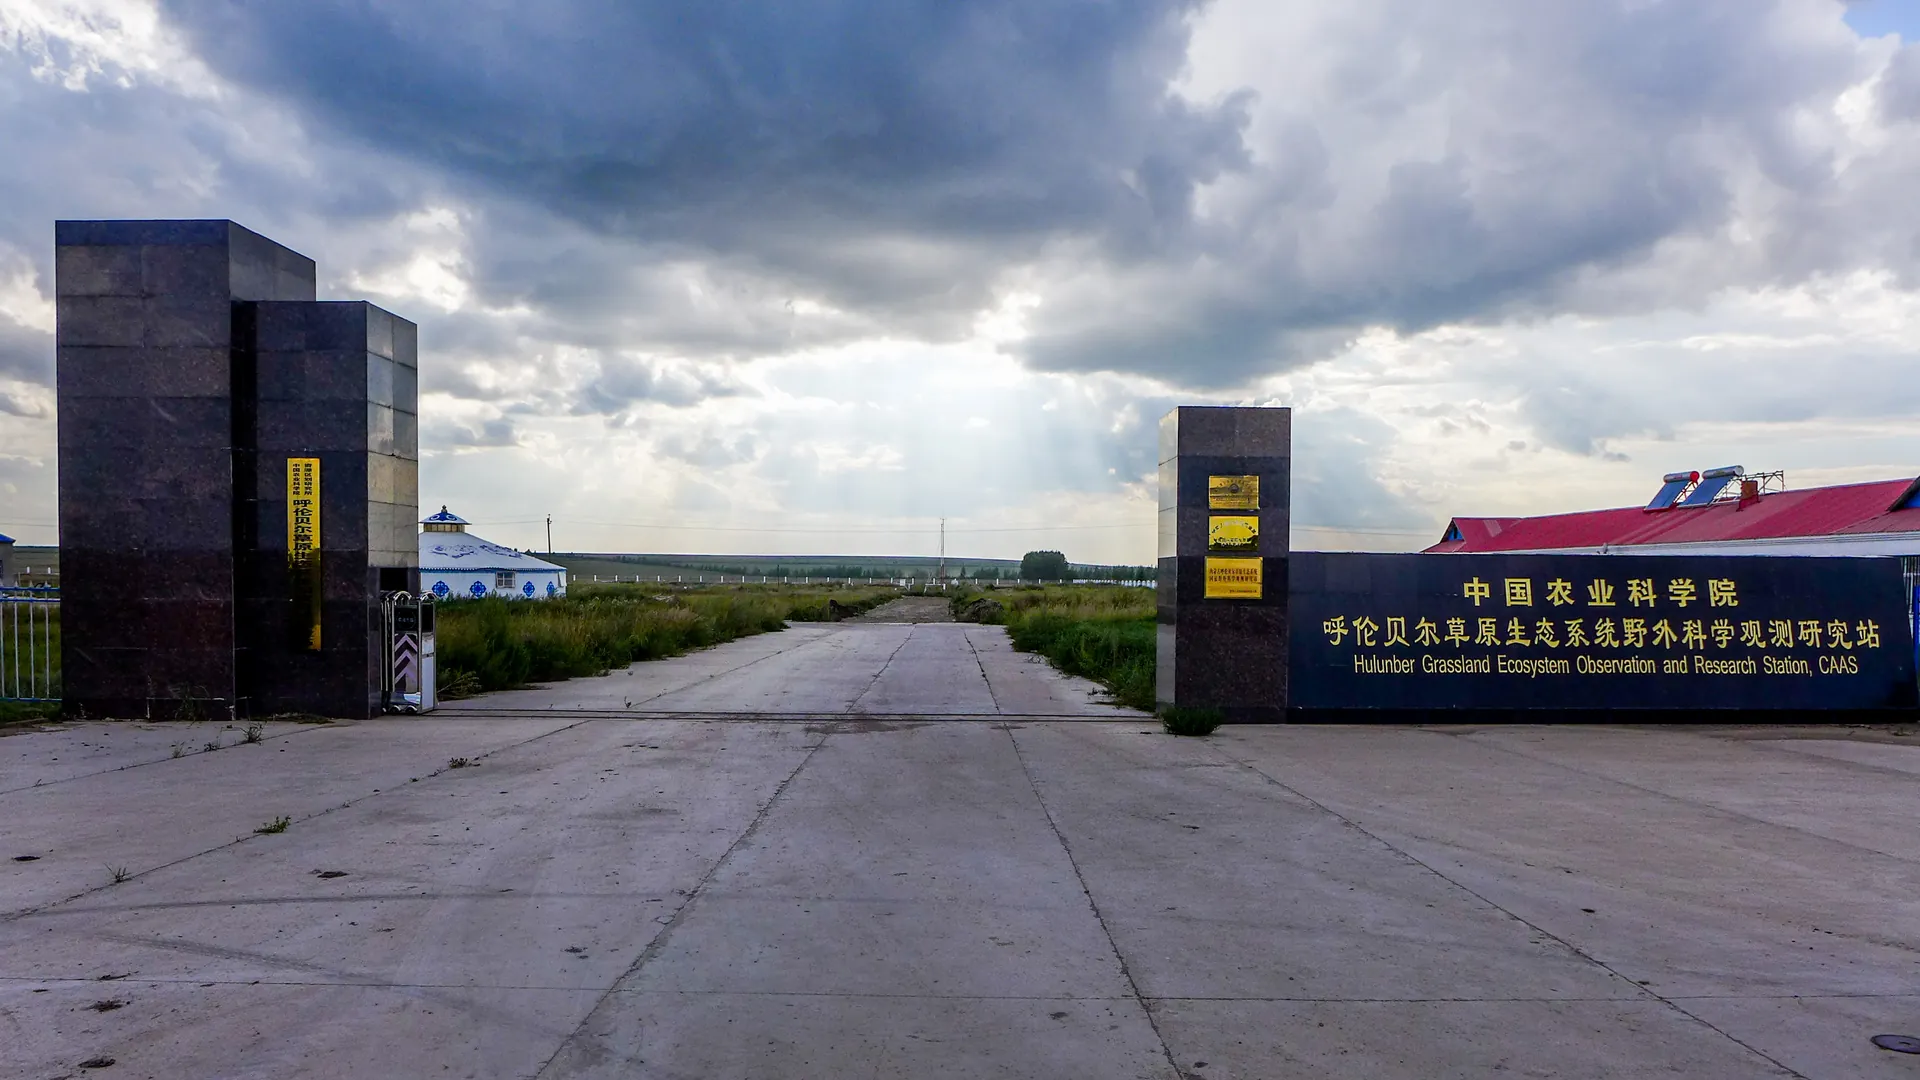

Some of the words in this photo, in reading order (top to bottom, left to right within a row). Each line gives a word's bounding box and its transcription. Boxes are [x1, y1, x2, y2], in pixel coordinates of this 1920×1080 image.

[1463, 577, 1739, 607] 中国农业科学院
[1323, 616, 1881, 649] 呼伦贝尔草原生态系统野外科学观测研究站
[1354, 655, 1415, 673] Hulunber
[1422, 655, 1490, 673] Grassland
[1497, 655, 1570, 678] Ecosystem
[1576, 655, 1656, 674] Observation
[1663, 656, 1688, 674] and
[1695, 656, 1756, 674] Research
[1763, 656, 1813, 677] Station,
[1818, 656, 1859, 674] CAAS
